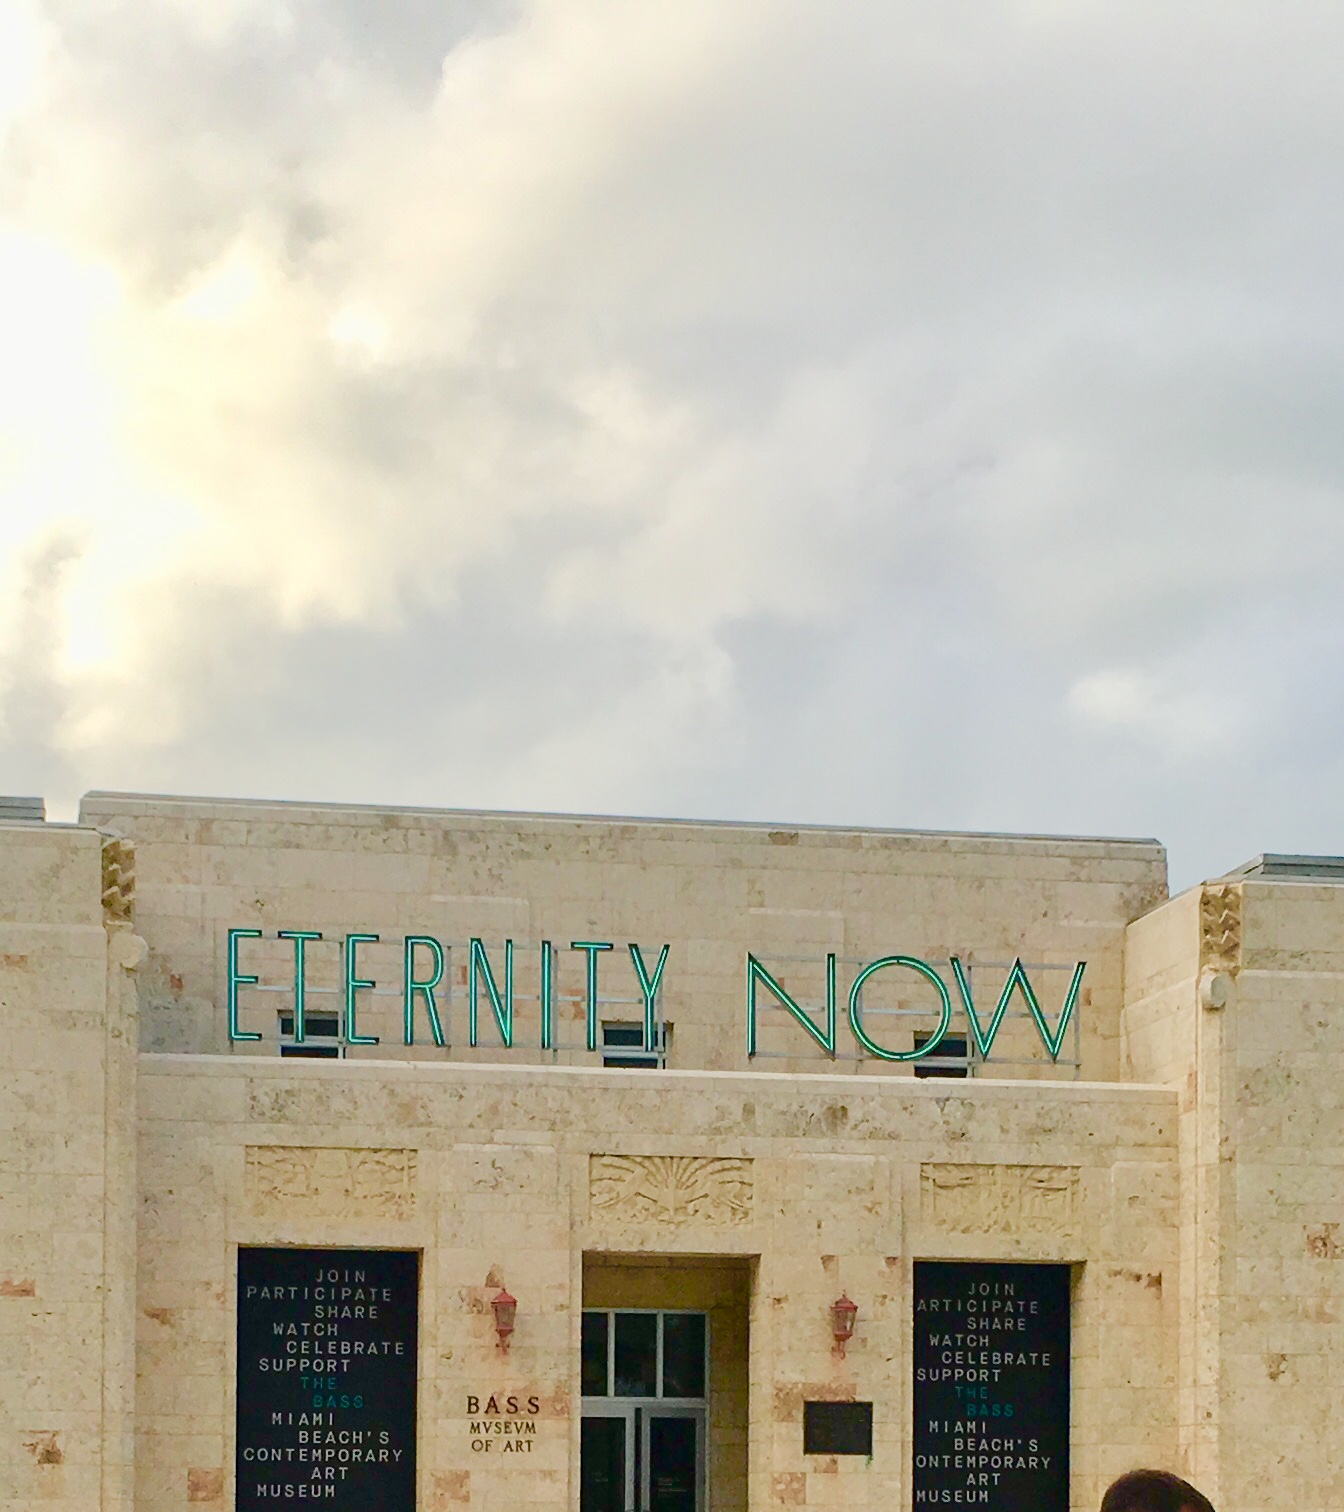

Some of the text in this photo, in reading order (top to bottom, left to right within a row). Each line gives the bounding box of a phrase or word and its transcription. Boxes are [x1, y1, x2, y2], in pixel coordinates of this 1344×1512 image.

[225, 928, 1088, 1062] ETERNITY NOW
[315, 1269, 365, 1283] JOIN
[246, 1286, 391, 1302] PARTICIPATE
[968, 1282, 1015, 1296] JOIN
[314, 1305, 378, 1319] SHARE
[917, 1299, 1038, 1314] ARTICIPATE
[273, 1322, 338, 1337] WATCH
[967, 1316, 1026, 1331] SHARE
[929, 1333, 989, 1347] WATCH
[286, 1340, 404, 1355] CELEBRATE
[259, 1358, 350, 1373] SUPPORT
[942, 1351, 1050, 1366] CELEBRATE
[917, 1368, 1001, 1382] SUPPORT
[300, 1376, 336, 1390] THE
[955, 1385, 988, 1399] THE
[313, 1394, 364, 1409] BASS
[467, 1395, 539, 1414] BASS
[967, 1403, 1014, 1417] BASS
[272, 1412, 334, 1426] MIAMI
[470, 1421, 536, 1434] MVSEVM
[929, 1420, 986, 1434] MIAMI
[298, 1430, 389, 1445] BEACH'S
[471, 1439, 534, 1452] OF ART
[954, 1438, 1038, 1452] BEACH'S
[243, 1447, 402, 1463] CONTEMPORARY
[916, 1455, 1050, 1470] ONTEMPORARY
[310, 1466, 348, 1480] ART
[966, 1472, 1001, 1486] ART
[257, 1484, 335, 1498] MUSEUM
[916, 1489, 989, 1503] MUSEUM
